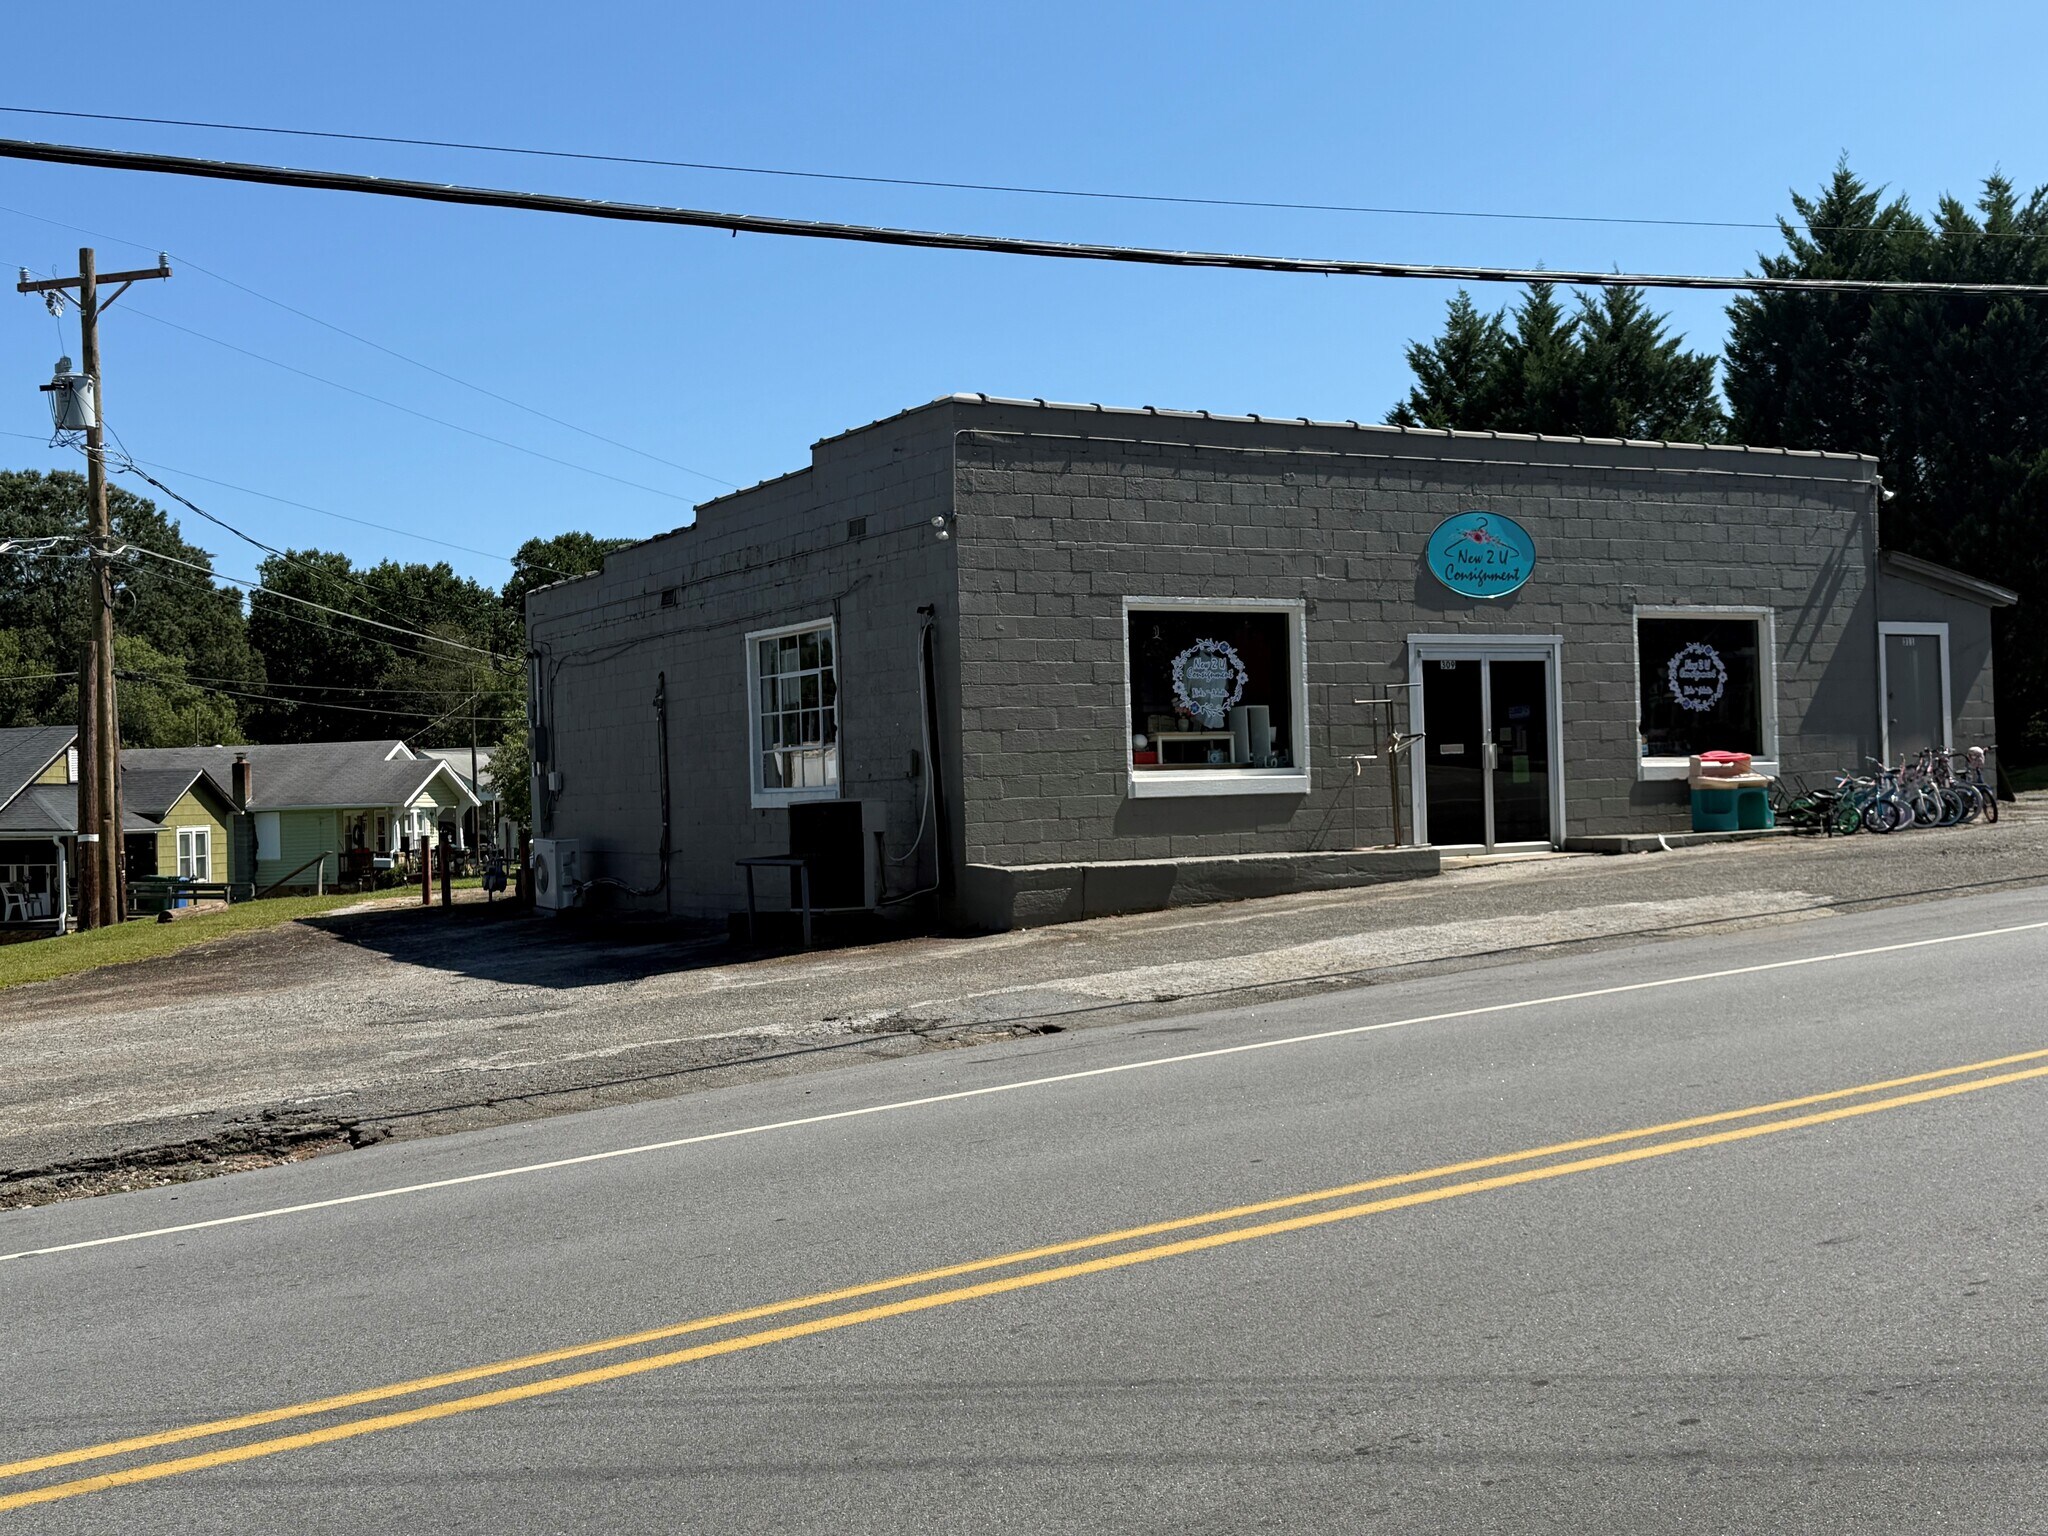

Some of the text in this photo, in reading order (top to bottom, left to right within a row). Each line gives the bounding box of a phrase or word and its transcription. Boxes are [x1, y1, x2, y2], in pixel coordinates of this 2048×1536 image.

[1458, 548, 1509, 565] New 2 U
[1445, 563, 1519, 587] Consignment
[1193, 657, 1210, 670] New
[1210, 657, 1218, 670] 2
[1441, 660, 1455, 669] 309
[1186, 667, 1234, 682] Consignment
